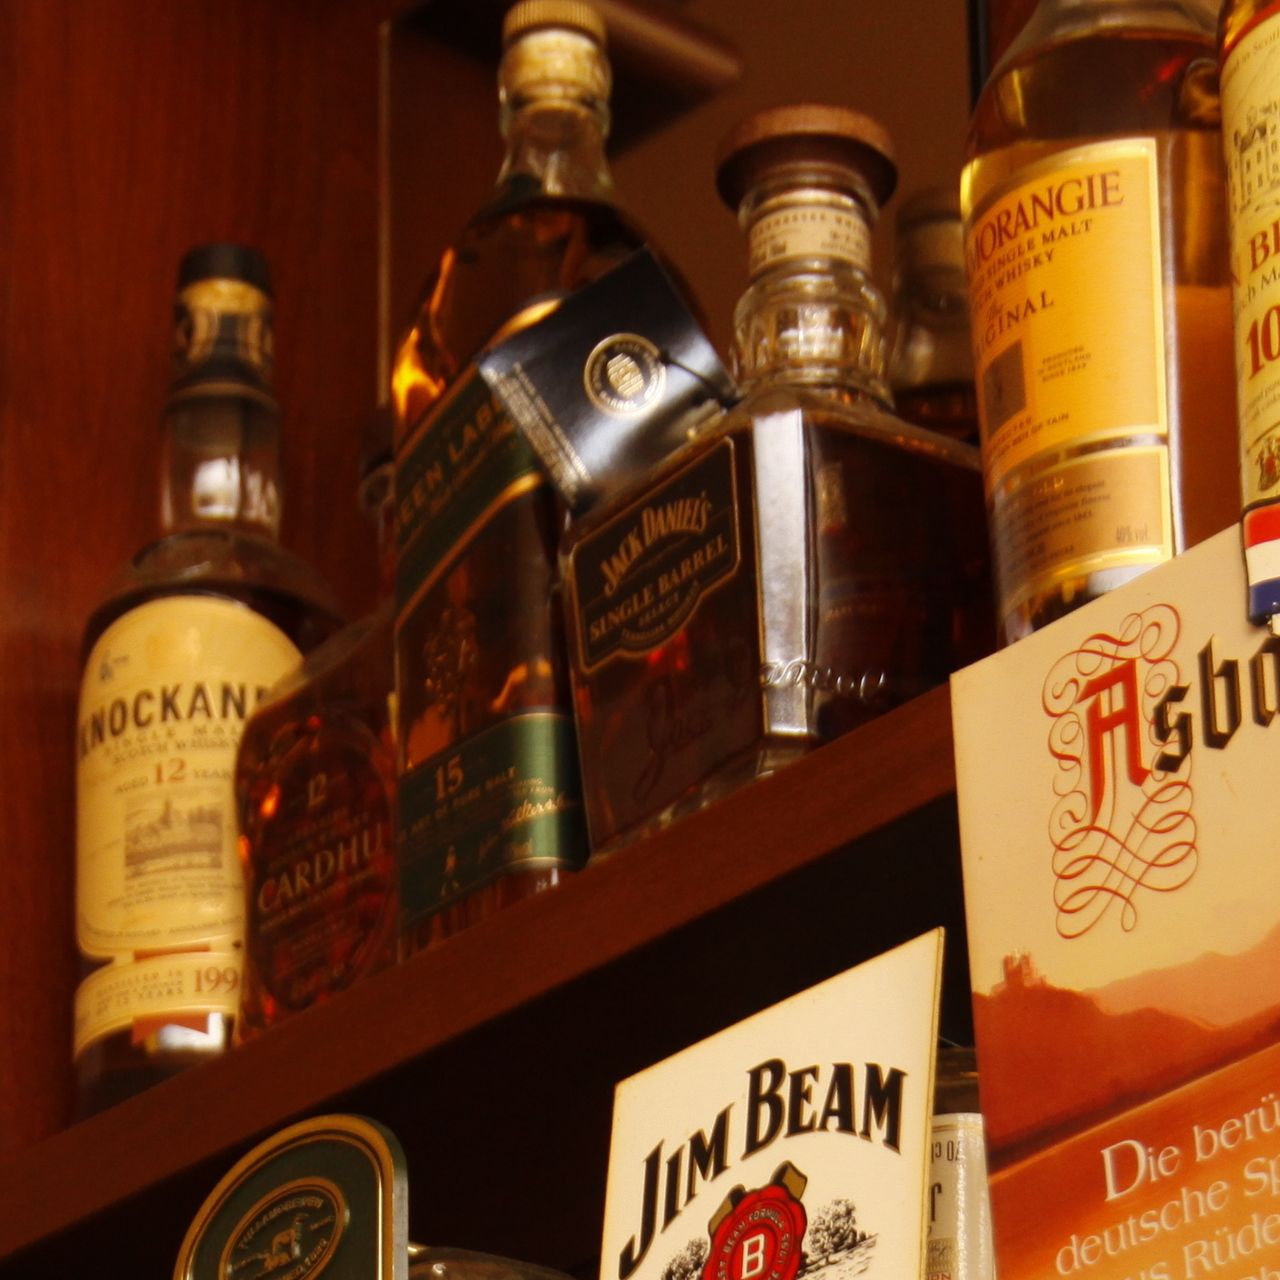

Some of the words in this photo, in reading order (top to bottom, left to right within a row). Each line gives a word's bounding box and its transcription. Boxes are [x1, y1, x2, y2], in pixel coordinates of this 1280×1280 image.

[1042, 218, 1093, 246] MALT
[600, 527, 643, 598] JACK
[589, 583, 656, 643] SINGLE
[153, 757, 187, 785] 12
[193, 769, 234, 780] YEAR
[435, 753, 465, 801] 15
[257, 823, 386, 913] CARDHU
[194, 965, 240, 994] 199
[741, 1058, 908, 1161] BEAM
[1099, 1138, 1182, 1202] Die
[722, 1220, 747, 1254] BEAM
[748, 1207, 785, 1230] FORMULA
[1054, 1177, 1230, 1277] deutsche
[740, 1233, 766, 1280] B
